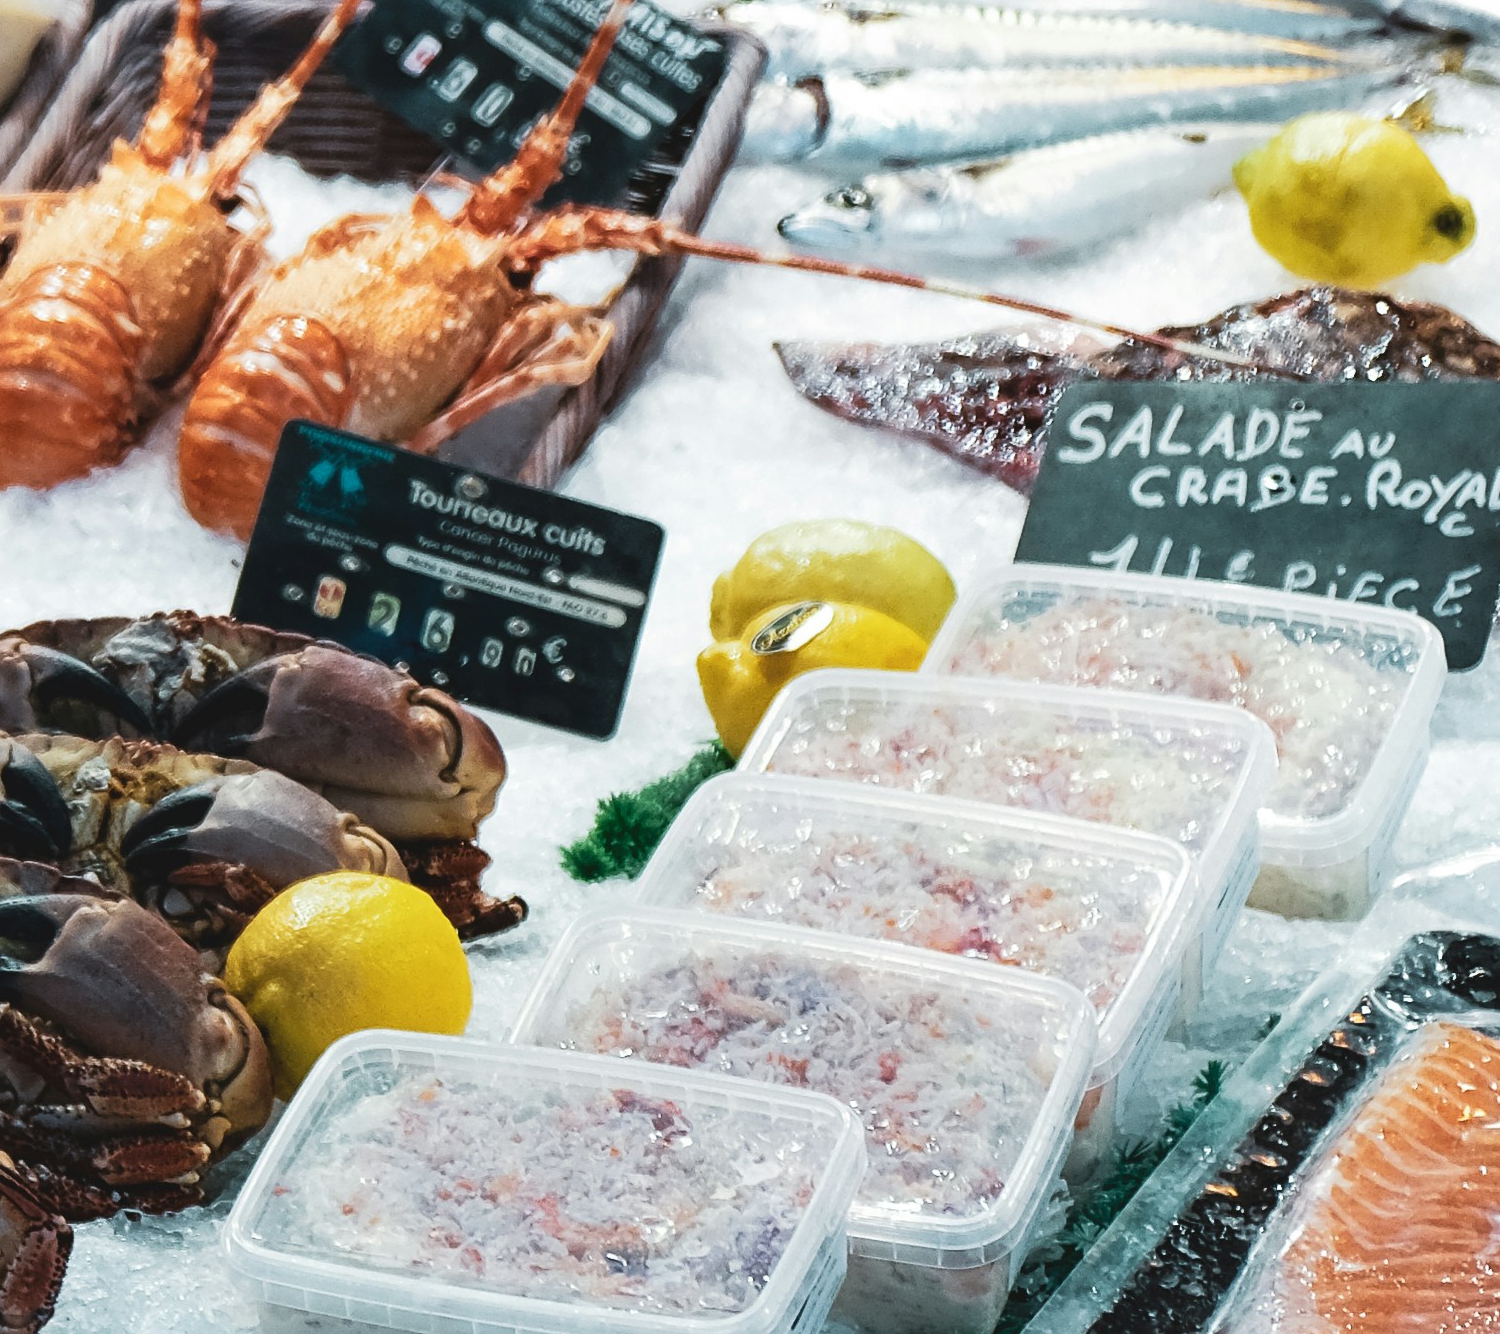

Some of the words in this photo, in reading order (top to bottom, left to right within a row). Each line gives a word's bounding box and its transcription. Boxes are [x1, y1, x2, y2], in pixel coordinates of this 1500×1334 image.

[1056, 400, 1323, 465] SALADE
[1329, 428, 1397, 461] AU
[408, 477, 537, 540] Tourteaux
[543, 524, 607, 557] cuits
[438, 518, 492, 547] Cancer
[498, 534, 562, 566] Pagurus
